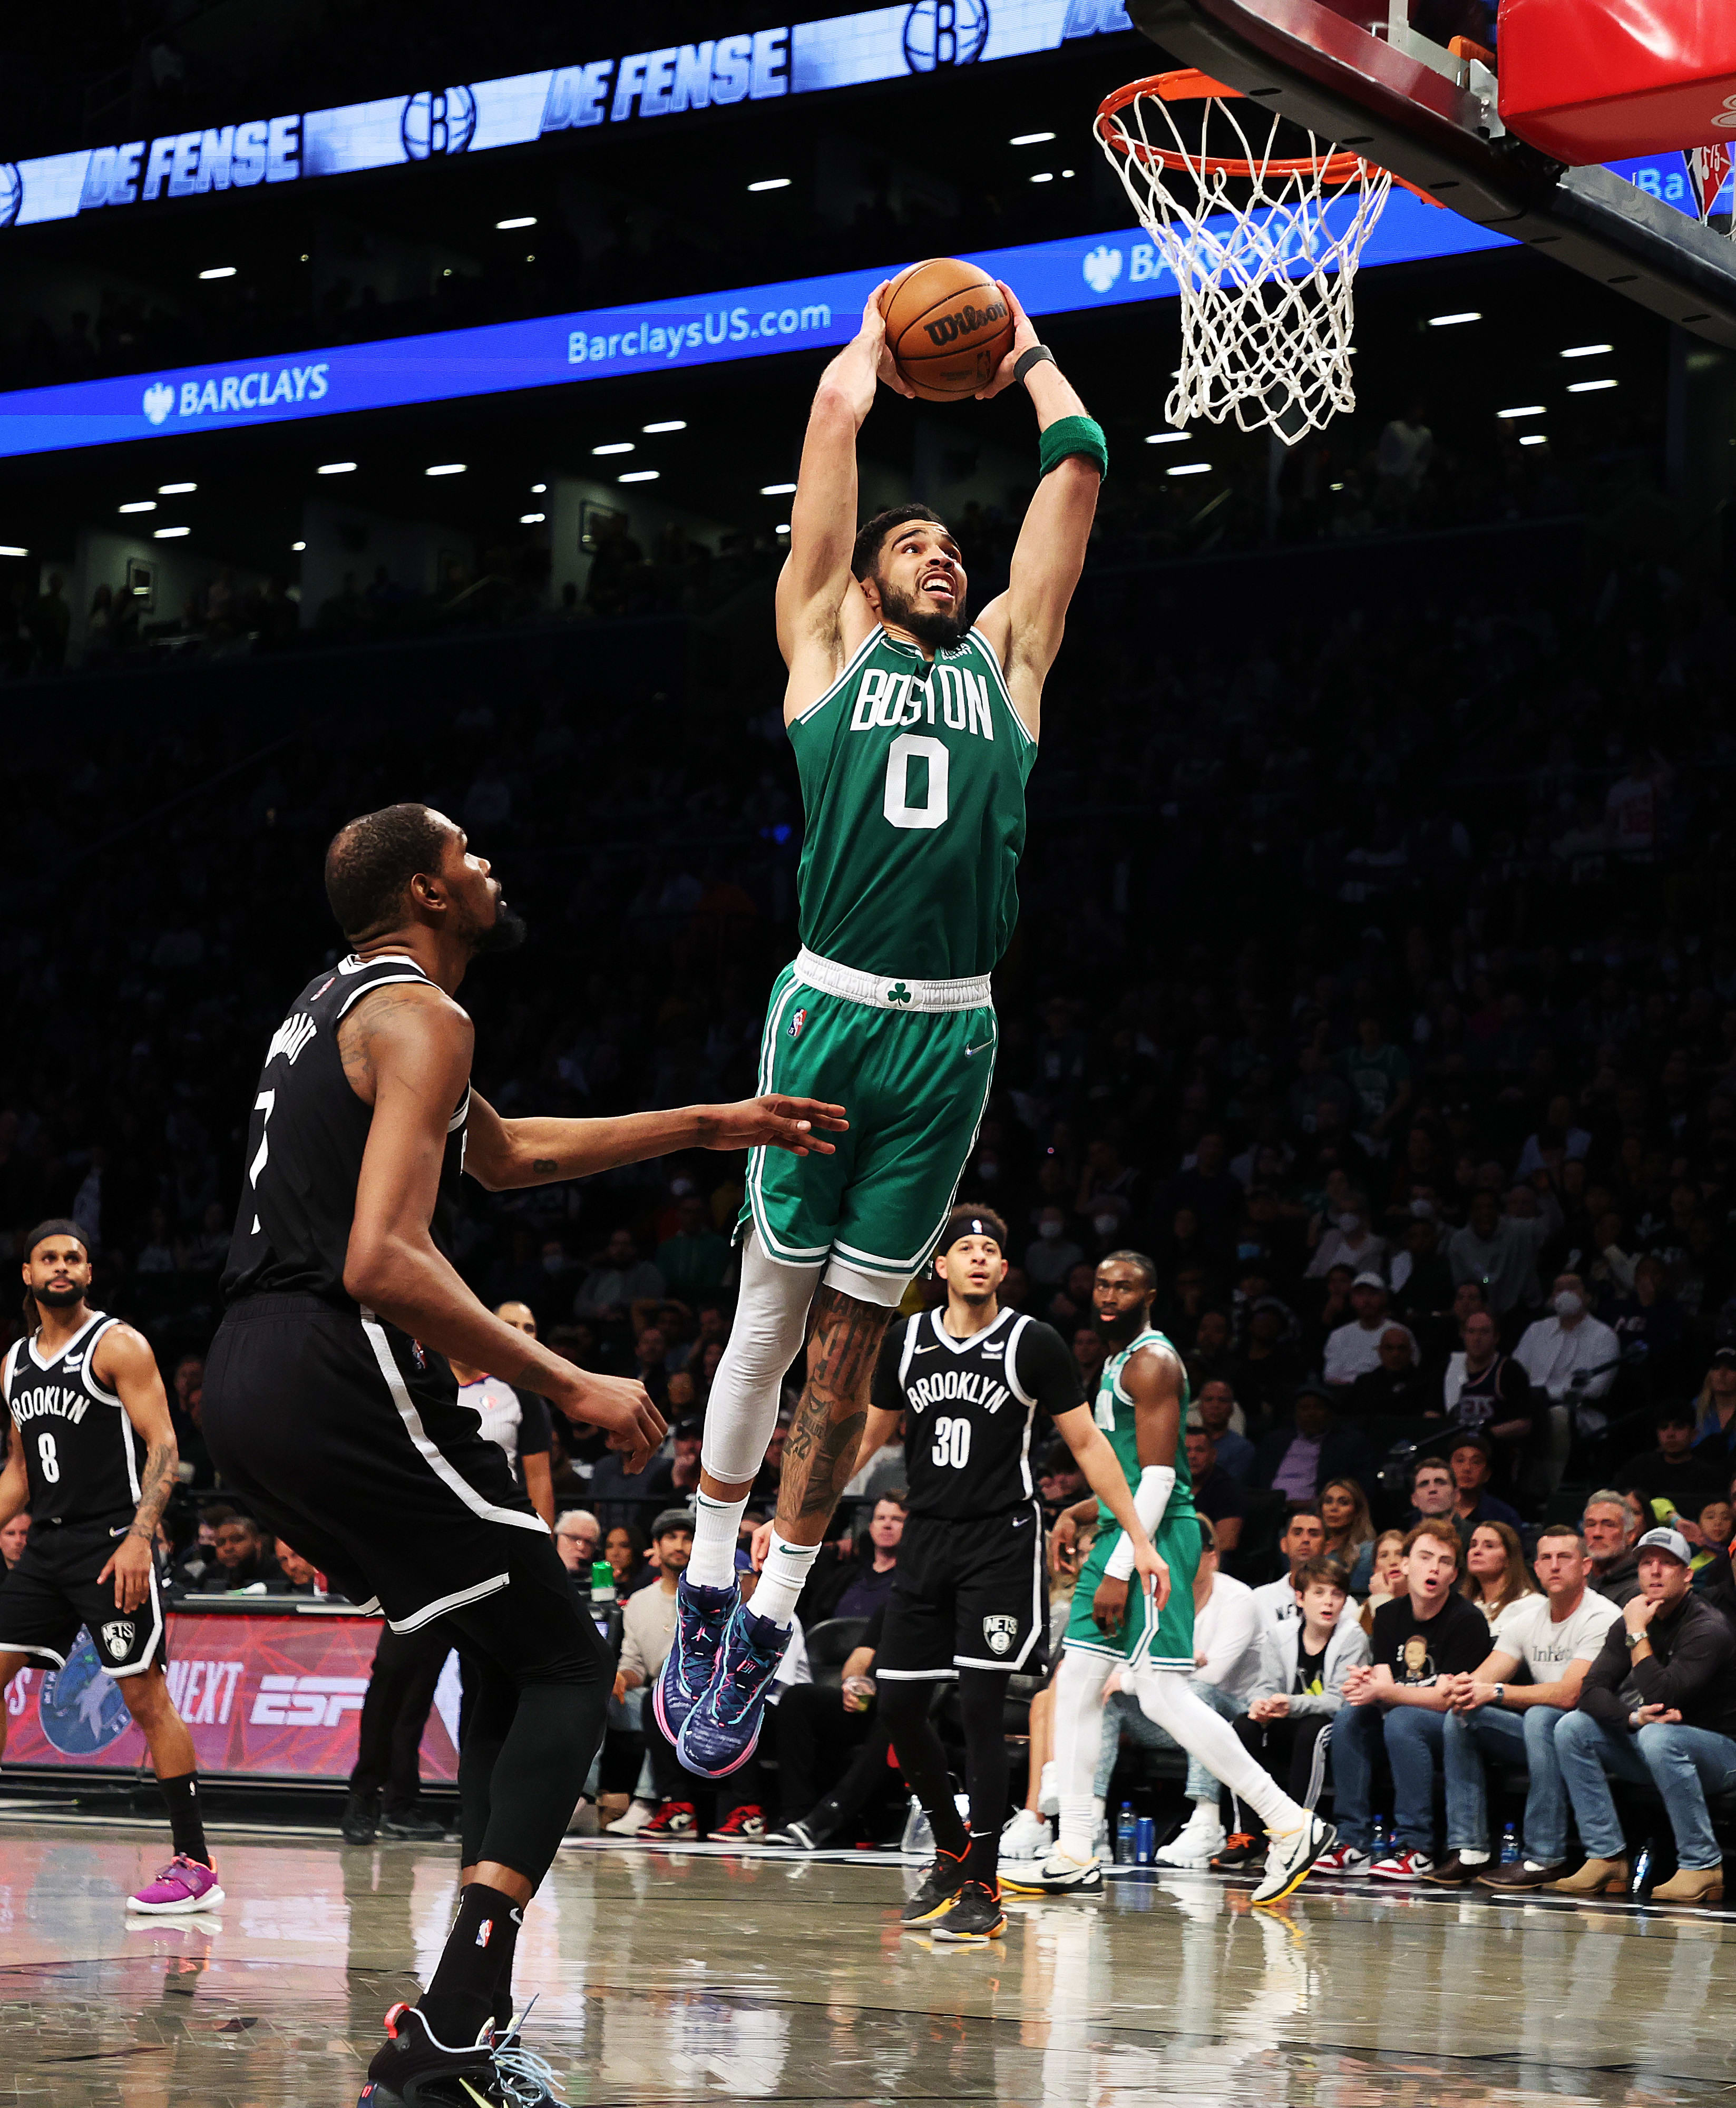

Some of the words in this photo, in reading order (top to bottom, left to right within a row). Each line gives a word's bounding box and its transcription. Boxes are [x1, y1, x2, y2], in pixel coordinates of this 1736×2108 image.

[542, 58, 614, 132] DE
[610, 26, 789, 122] FENSE
[79, 141, 145, 210] DE
[142, 114, 300, 201] FENSE
[568, 303, 832, 364] BarclaysUS.com
[923, 301, 1009, 346] Wilson
[178, 363, 330, 417] BARCLAYS
[850, 664, 994, 741] BOSTON
[883, 733, 949, 829] 0
[906, 1371, 1011, 1414] BROOKLYN
[38, 1432, 60, 1484] 8
[932, 1417, 972, 1469] 30
[103, 1622, 133, 1641] NETS
[985, 1617, 1017, 1634] NETS
[165, 1660, 244, 1725] NEXT
[249, 1674, 370, 1727] ESP
